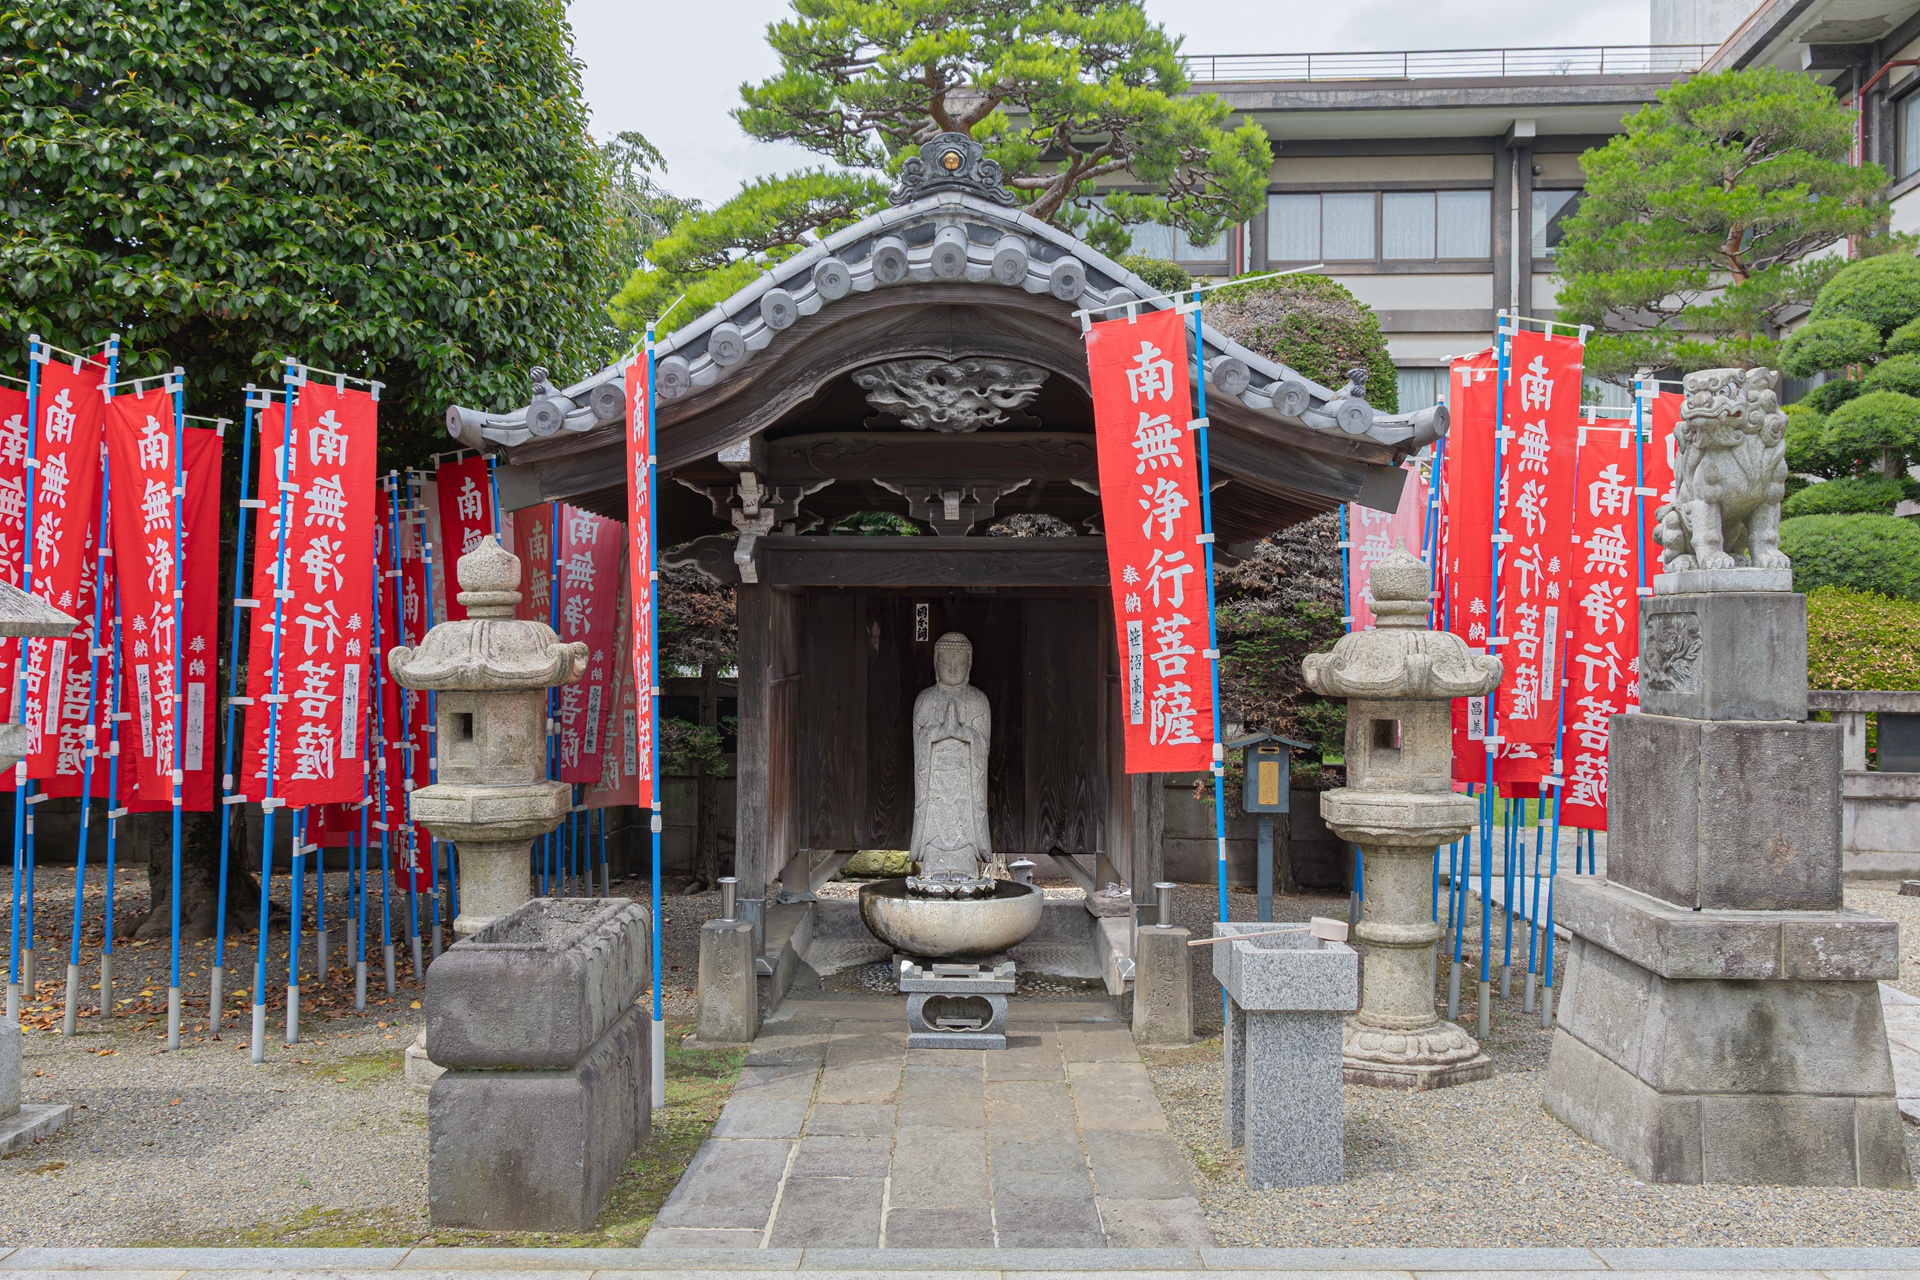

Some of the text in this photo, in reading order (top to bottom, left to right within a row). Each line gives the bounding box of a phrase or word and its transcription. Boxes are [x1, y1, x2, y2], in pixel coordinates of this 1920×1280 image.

[633, 381, 651, 781] 南無浄行菩薩
[1126, 341, 1201, 746] 南無浄行菩薩
[138, 415, 175, 777] 南無浄行菩薩
[1123, 565, 1142, 614] 奉納
[1469, 597, 1487, 642] 奉納
[132, 614, 149, 659] 奉納
[1129, 627, 1143, 716] 笹沼高志
